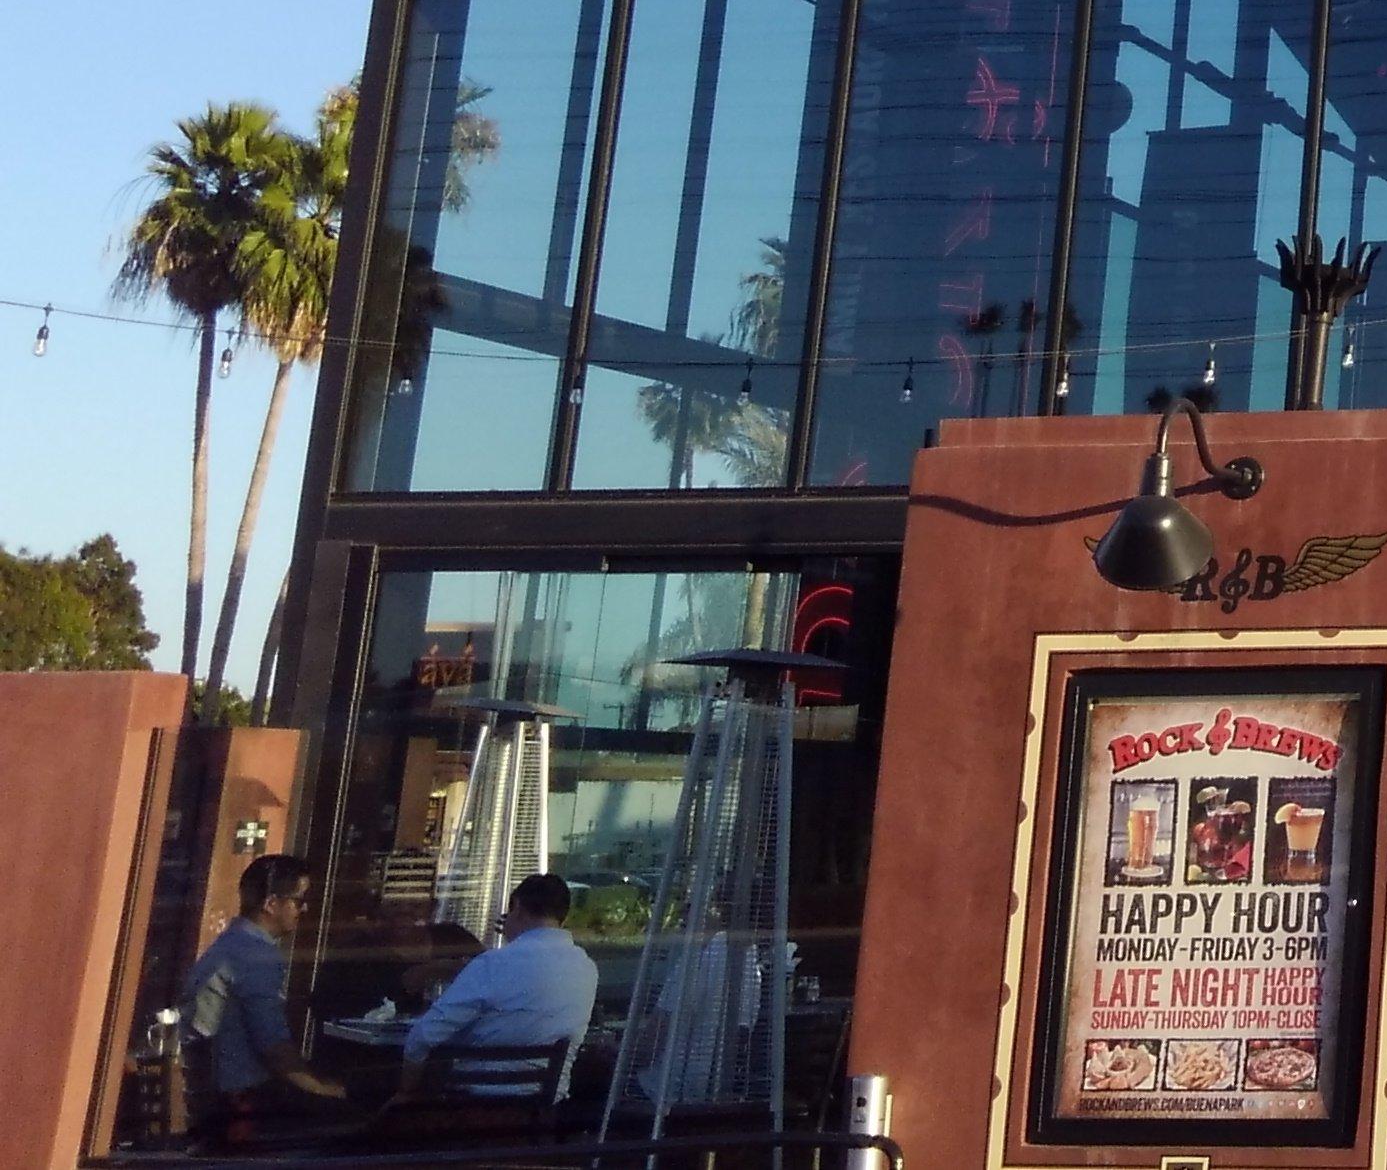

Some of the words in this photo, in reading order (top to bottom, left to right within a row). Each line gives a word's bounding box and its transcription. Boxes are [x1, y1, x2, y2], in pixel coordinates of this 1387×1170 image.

[1108, 723, 1205, 773] ROCK
[1228, 716, 1343, 771] BREWS
[1099, 892, 1222, 935] HAPPY
[1231, 892, 1331, 933] HOUR
[1262, 936, 1329, 961] 3-6PM
[1092, 968, 1163, 1007] LATE
[1170, 968, 1261, 1007] NIGHT
[1262, 967, 1326, 987] HAPPY
[1261, 986, 1322, 1006] HOUR
